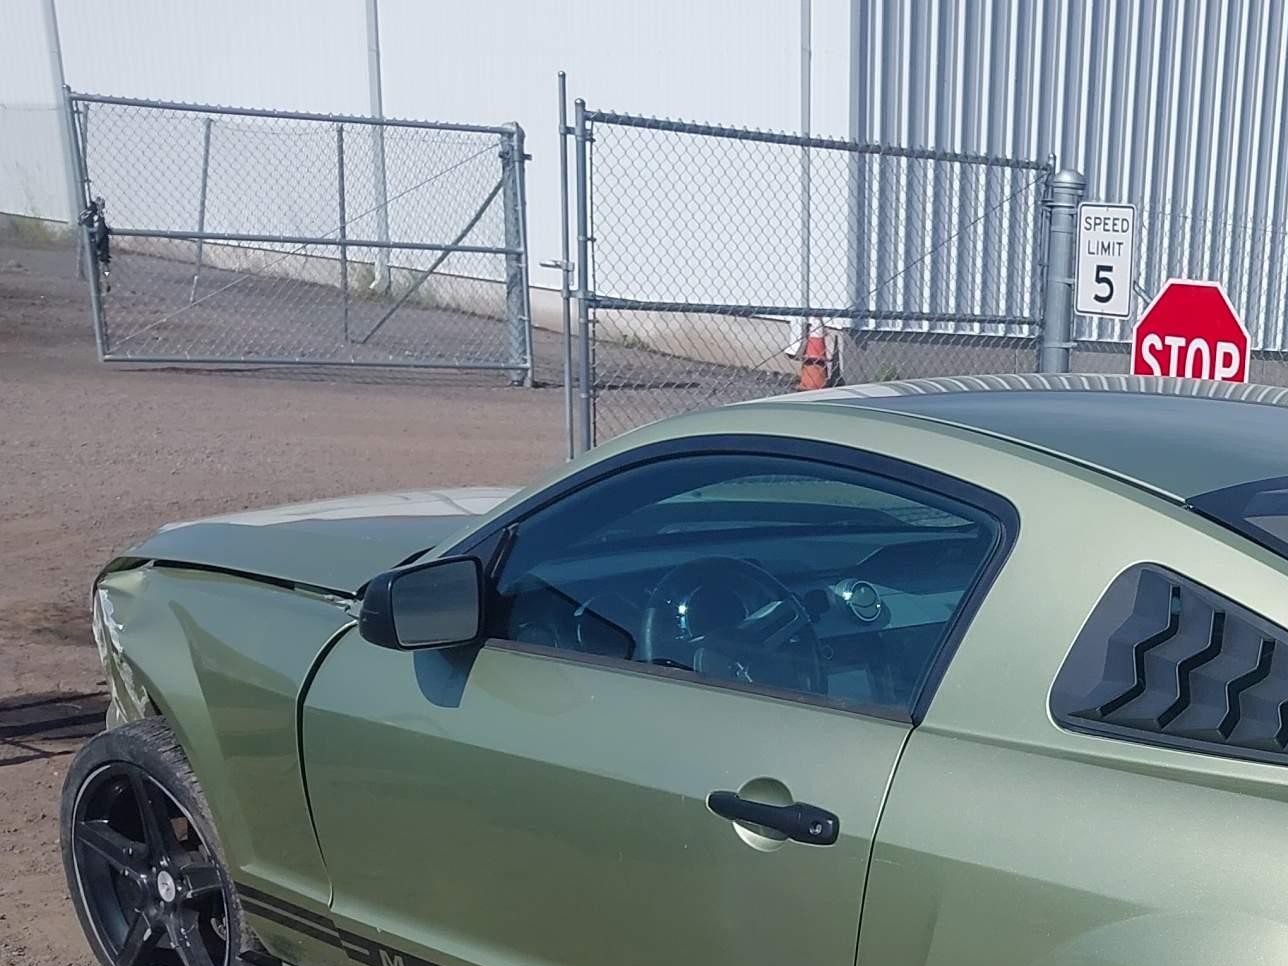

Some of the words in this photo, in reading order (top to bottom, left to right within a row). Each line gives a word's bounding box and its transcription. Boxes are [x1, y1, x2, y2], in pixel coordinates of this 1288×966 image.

[1083, 215, 1130, 234] SPEED
[1087, 240, 1124, 257] LIMIT
[1092, 264, 1114, 304] 5
[1141, 333, 1240, 381] STOP
